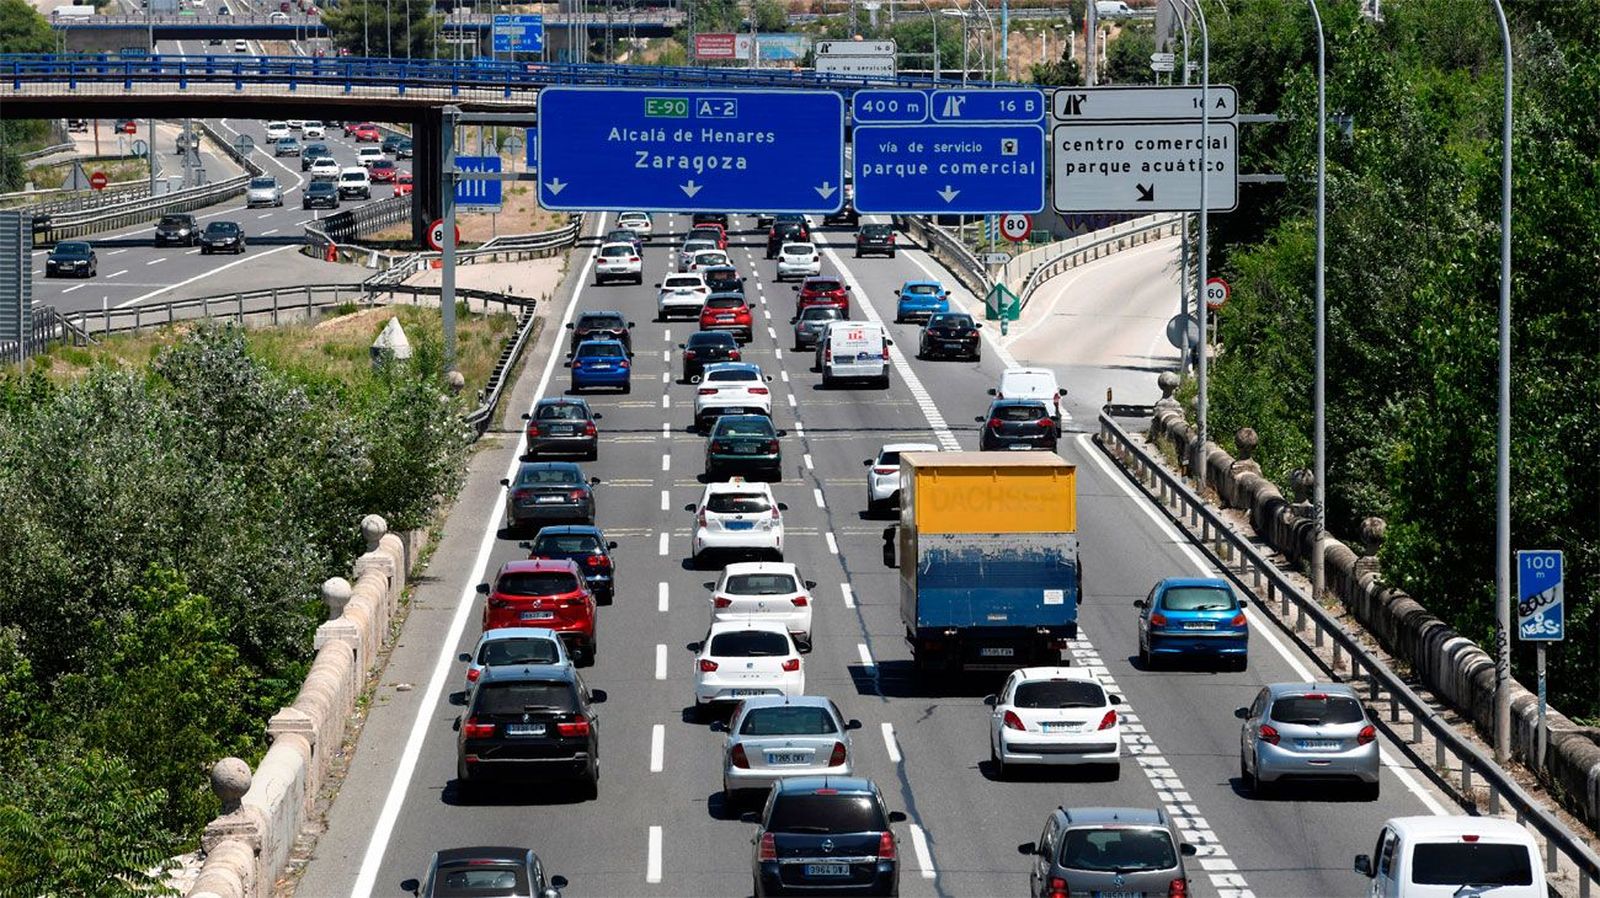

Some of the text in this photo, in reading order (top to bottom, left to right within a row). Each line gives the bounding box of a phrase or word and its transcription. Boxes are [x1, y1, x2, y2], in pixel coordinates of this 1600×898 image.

[647, 101, 735, 116] E-90 A-2
[862, 100, 919, 113] 400 m
[1000, 100, 1035, 112] 16 B
[1216, 97, 1227, 109] A
[608, 126, 775, 143] Alcalá de Henares
[879, 141, 983, 153] vía de servicio
[1062, 136, 1228, 151] centro comercial
[634, 151, 747, 174] Zaragoza
[862, 160, 1035, 178] parque comercial
[1066, 158, 1225, 176] parque acuático
[1007, 219, 1025, 230] 80
[434, 230, 443, 241] 8
[1207, 288, 1224, 299] 60
[1526, 556, 1555, 569] 100
